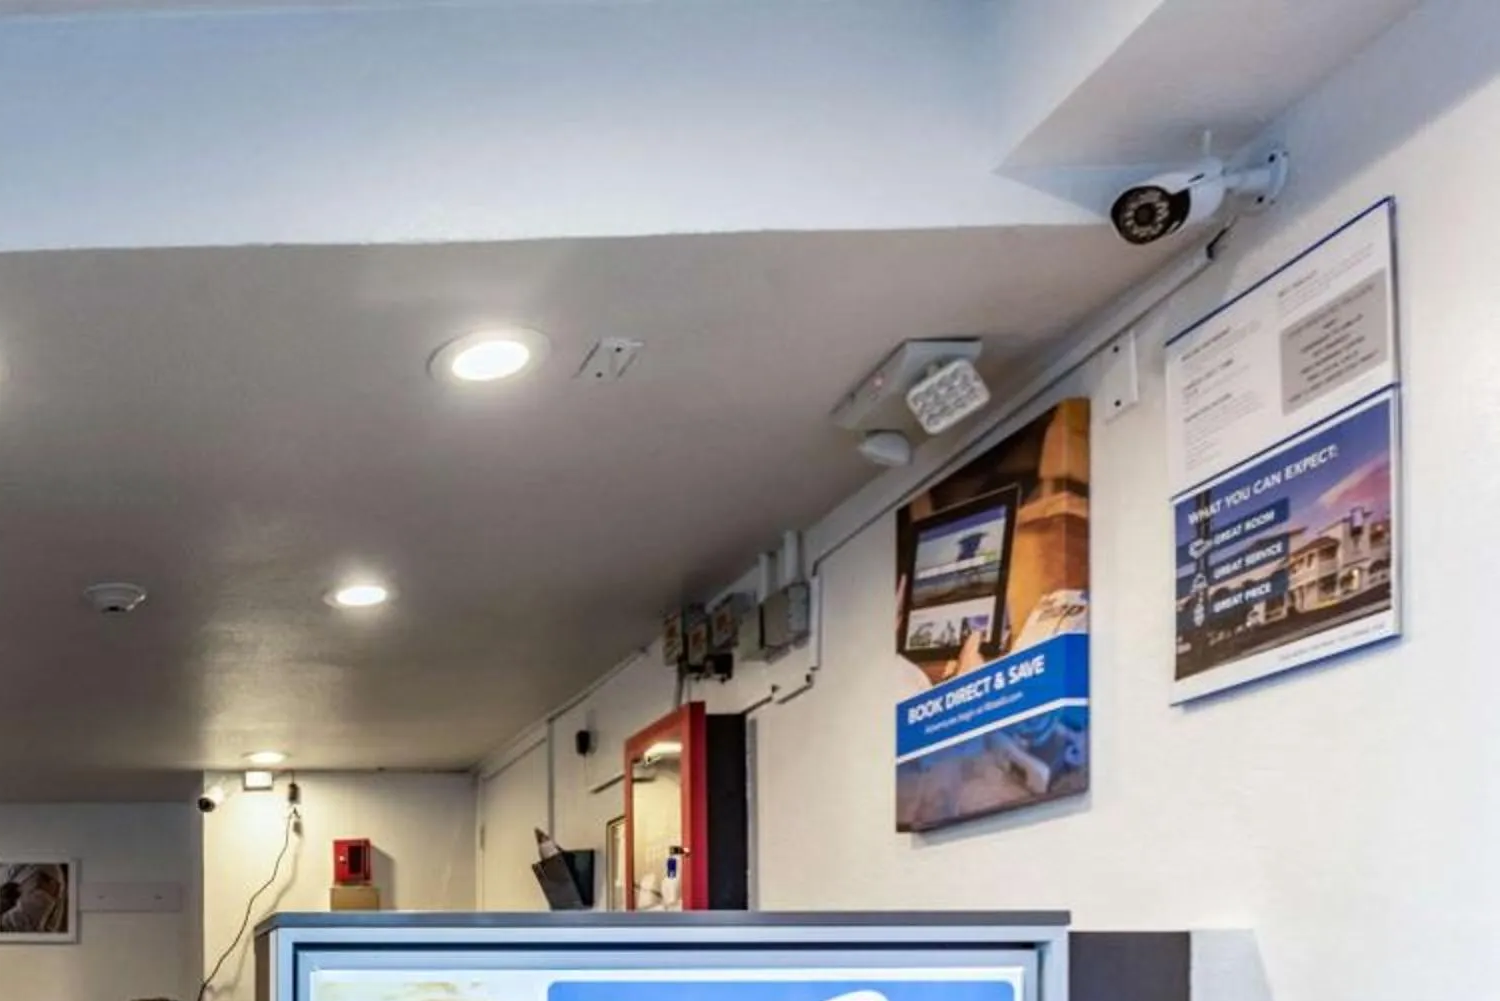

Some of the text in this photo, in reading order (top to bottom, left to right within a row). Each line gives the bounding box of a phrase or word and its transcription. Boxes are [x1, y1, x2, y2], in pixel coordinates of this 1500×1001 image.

[1187, 499, 1222, 526] WHAT
[1225, 487, 1250, 509] YOU
[1253, 470, 1282, 495] CAN
[1213, 510, 1276, 546] GREAT ROOM
[1213, 541, 1284, 580] GREAT SERVICE
[1213, 581, 1273, 613] GREAT PRICE
[907, 696, 944, 725] BOOK
[945, 675, 992, 711] DIRECT
[993, 670, 1005, 690] &
[1008, 653, 1046, 685] SAVE
